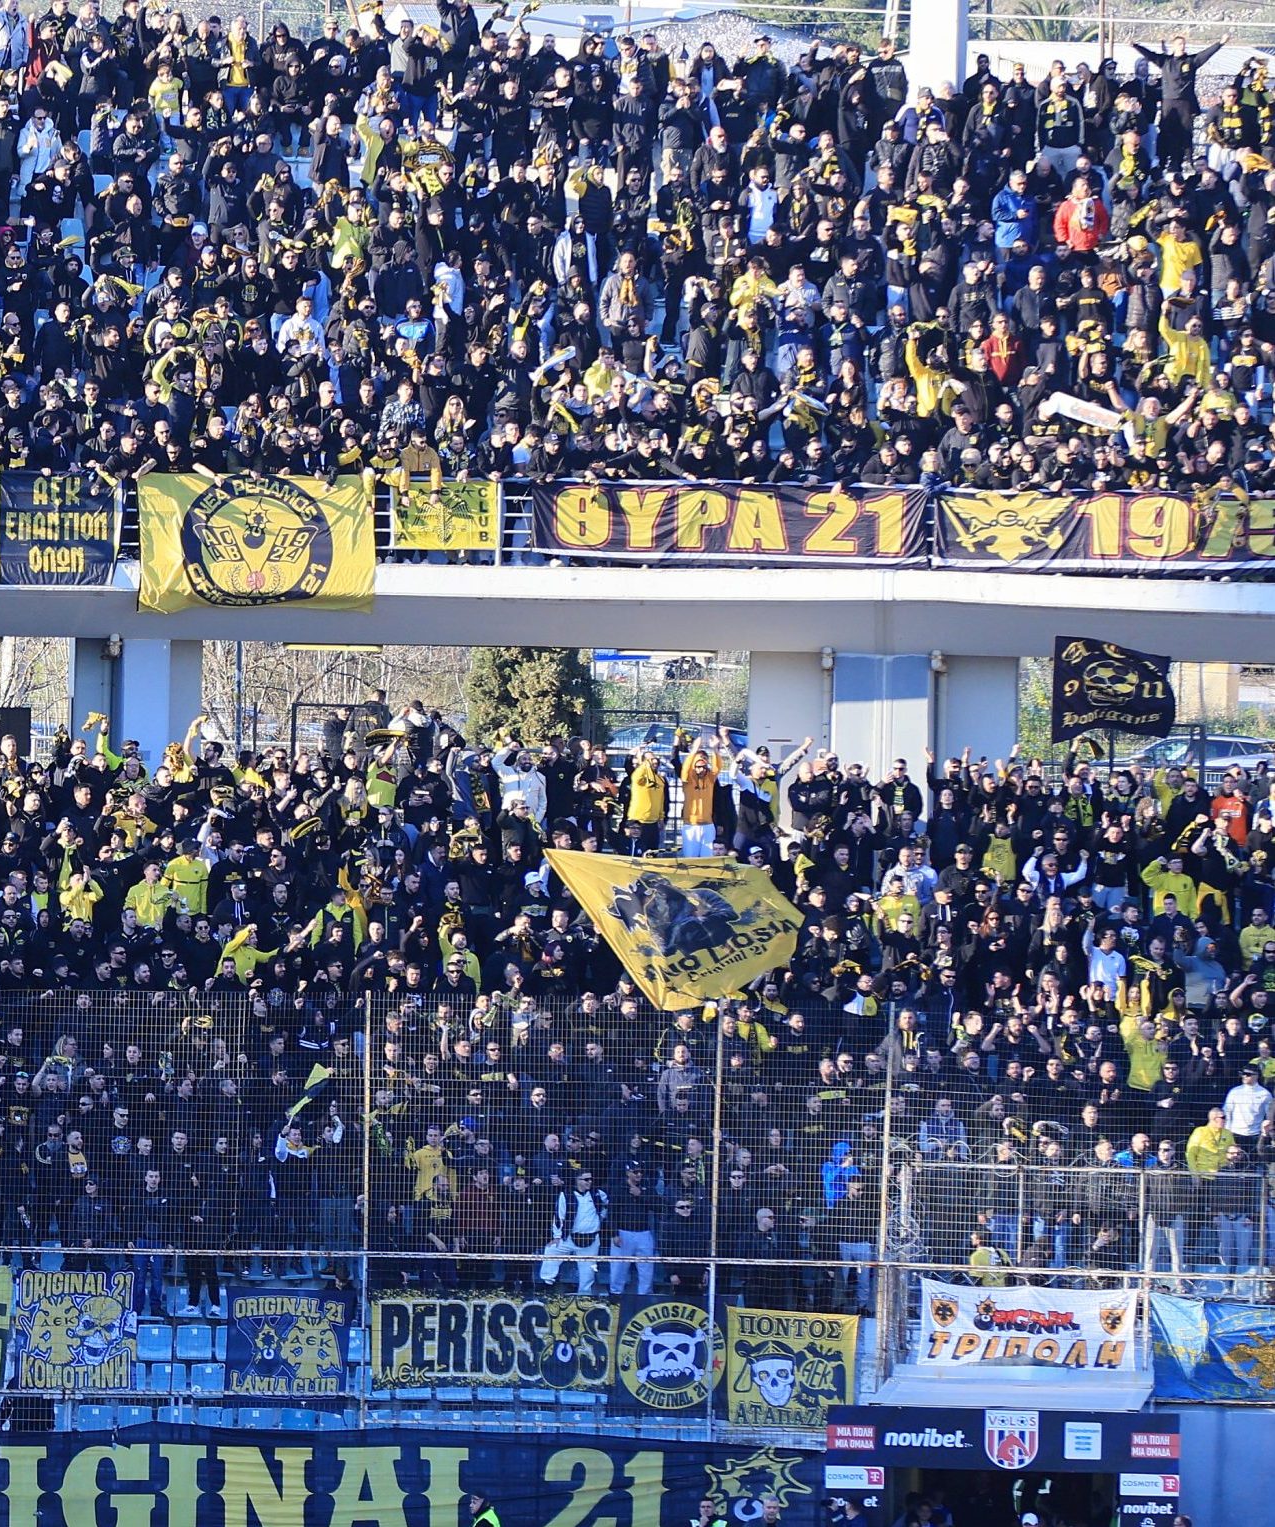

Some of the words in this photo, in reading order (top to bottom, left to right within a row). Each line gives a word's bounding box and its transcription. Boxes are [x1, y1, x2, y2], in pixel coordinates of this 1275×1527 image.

[554, 486, 789, 552] ΘΥΡΑ
[802, 490, 907, 557] 21
[1064, 680, 1080, 697] 9
[22, 1272, 107, 1307] ORIGINAL
[112, 1273, 133, 1309] 21
[234, 1297, 321, 1319] ORIGINAL
[325, 1302, 343, 1323] 21
[622, 1319, 644, 1349] ANO
[643, 1305, 698, 1323] LIOSIA
[739, 1315, 843, 1340] ΠΟΝΤΟΣ
[928, 1331, 1126, 1368] ΤΡΙΠΟΛΗ
[21, 1350, 127, 1388] ΚΟΜΟΤΗΝΗ
[230, 1371, 289, 1396] LAMIA
[292, 1376, 337, 1397] CLUB
[636, 1384, 695, 1407] ORIGINAL
[988, 1416, 1036, 1426] VOLOS
[836, 1427, 851, 1437] ΜΙΑ
[852, 1427, 873, 1437] ΠΟΛΗ
[884, 1428, 965, 1448] novibet
[1133, 1435, 1148, 1445] ΜΙΑ
[1149, 1435, 1170, 1445] ΠΟΛΗ
[835, 1439, 849, 1448] ΜΙΑ
[1132, 1447, 1145, 1456] ΜΙΑ
[544, 1446, 673, 1527] 21
[827, 1473, 864, 1481] COSMOTE
[1122, 1480, 1160, 1488] COSMOTE
[1122, 1502, 1174, 1514] novibet
